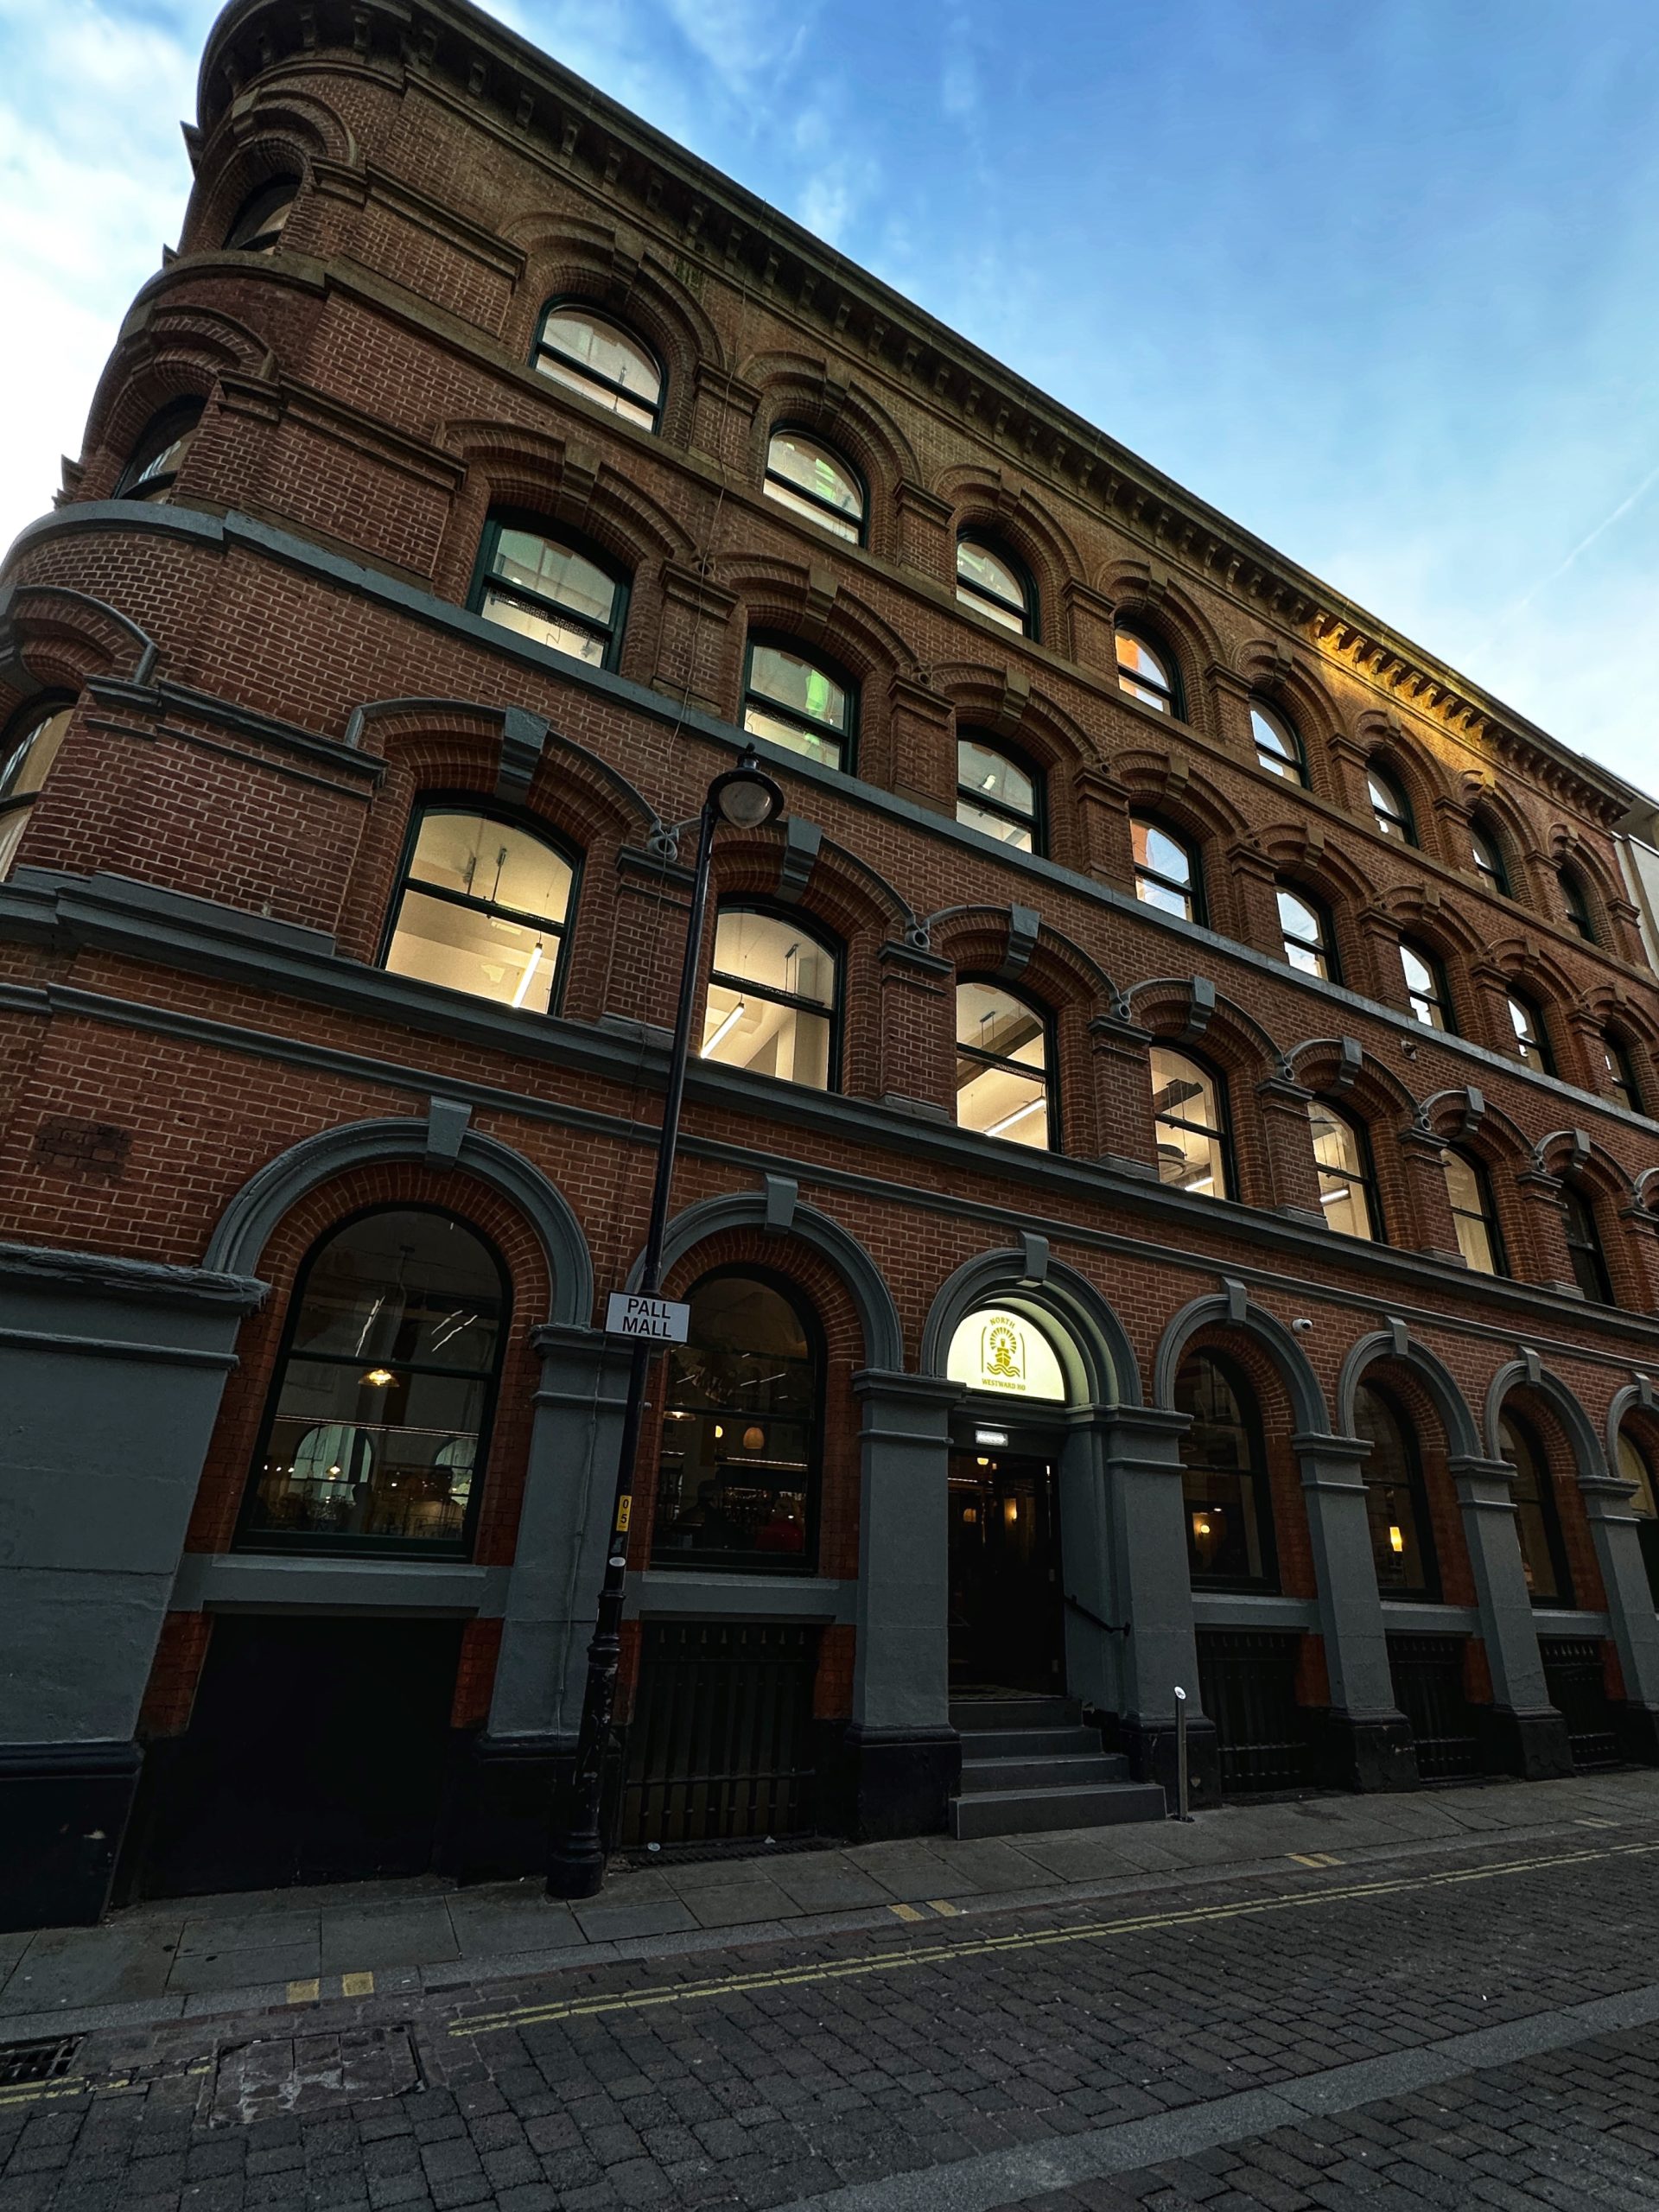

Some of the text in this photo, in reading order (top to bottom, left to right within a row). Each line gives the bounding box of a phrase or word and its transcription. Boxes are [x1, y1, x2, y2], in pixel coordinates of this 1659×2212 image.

[627, 1298, 671, 1319] PALL
[622, 1316, 671, 1338] MALL
[989, 1316, 1015, 1329] NORTH
[982, 1378, 1016, 1389] WESTWARD
